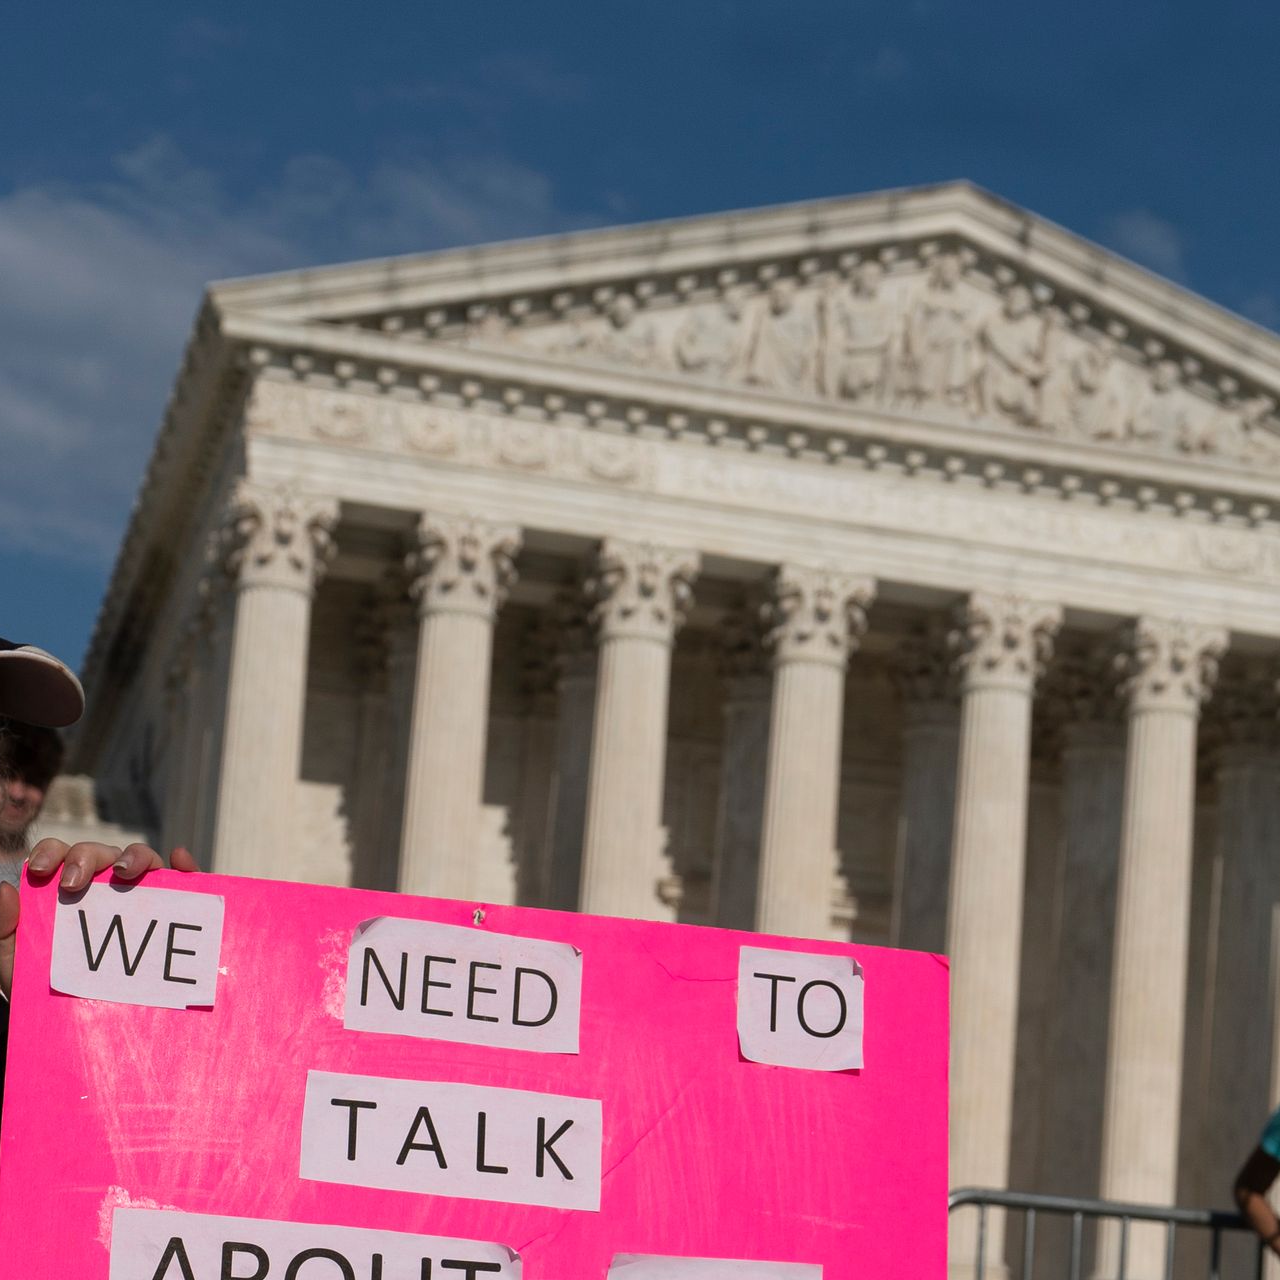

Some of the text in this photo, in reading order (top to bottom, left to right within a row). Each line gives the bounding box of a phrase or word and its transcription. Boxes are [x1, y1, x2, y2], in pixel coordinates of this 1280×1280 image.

[77, 908, 848, 1040] WE NEED TO
[330, 1097, 575, 1181] TALK
